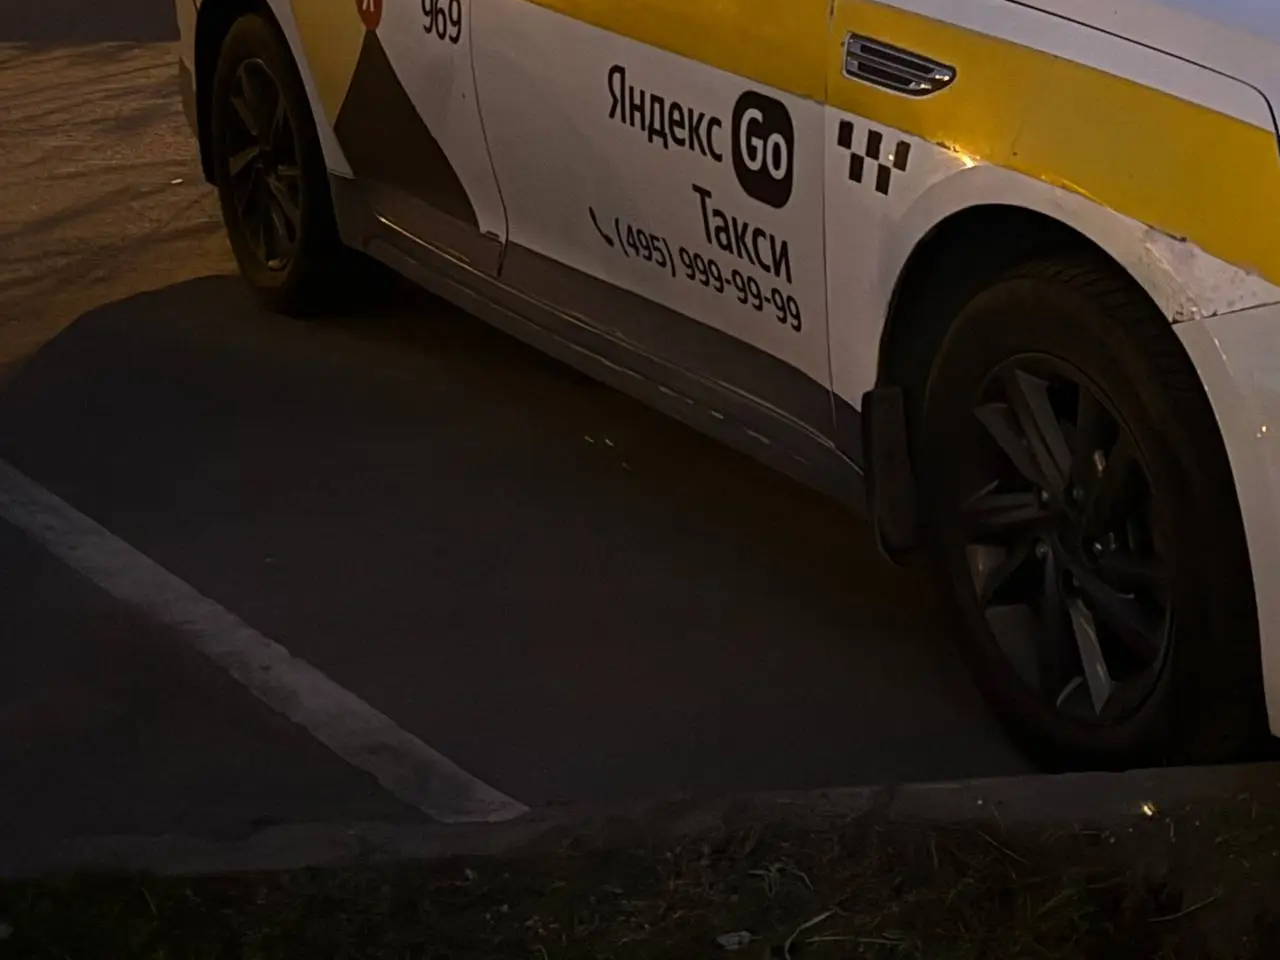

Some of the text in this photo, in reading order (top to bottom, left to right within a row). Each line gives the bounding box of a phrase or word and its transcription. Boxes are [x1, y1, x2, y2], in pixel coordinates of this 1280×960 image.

[607, 64, 788, 181] Яндекс Go
[614, 216, 803, 333] (495) 999-99-99
[692, 183, 792, 284] Такси
